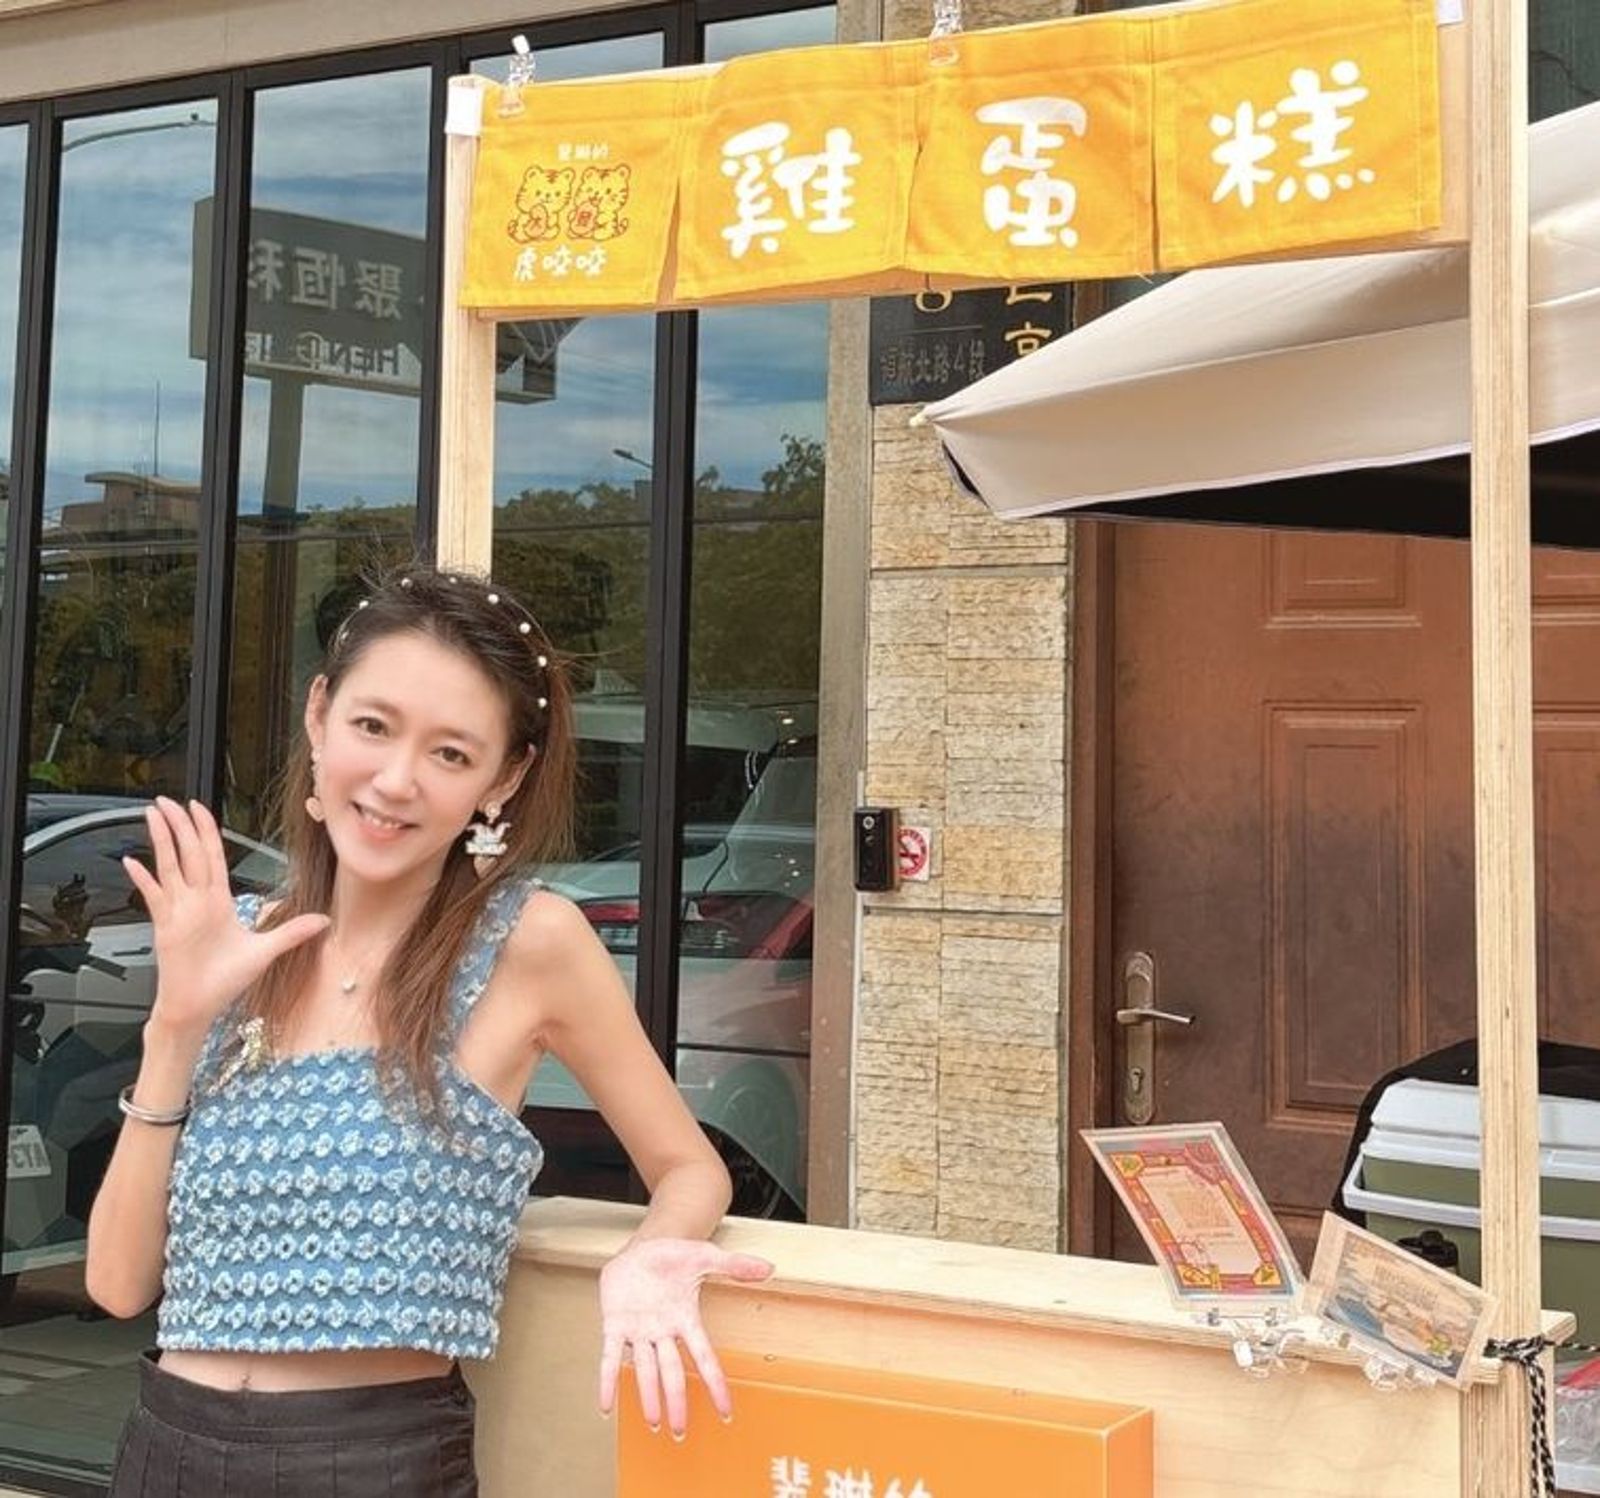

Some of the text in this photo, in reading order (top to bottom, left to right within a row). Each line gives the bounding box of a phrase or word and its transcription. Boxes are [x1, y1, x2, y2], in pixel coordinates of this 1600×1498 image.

[720, 59, 1376, 259] 雞蛋糕
[513, 246, 608, 281] 虎咬咬
